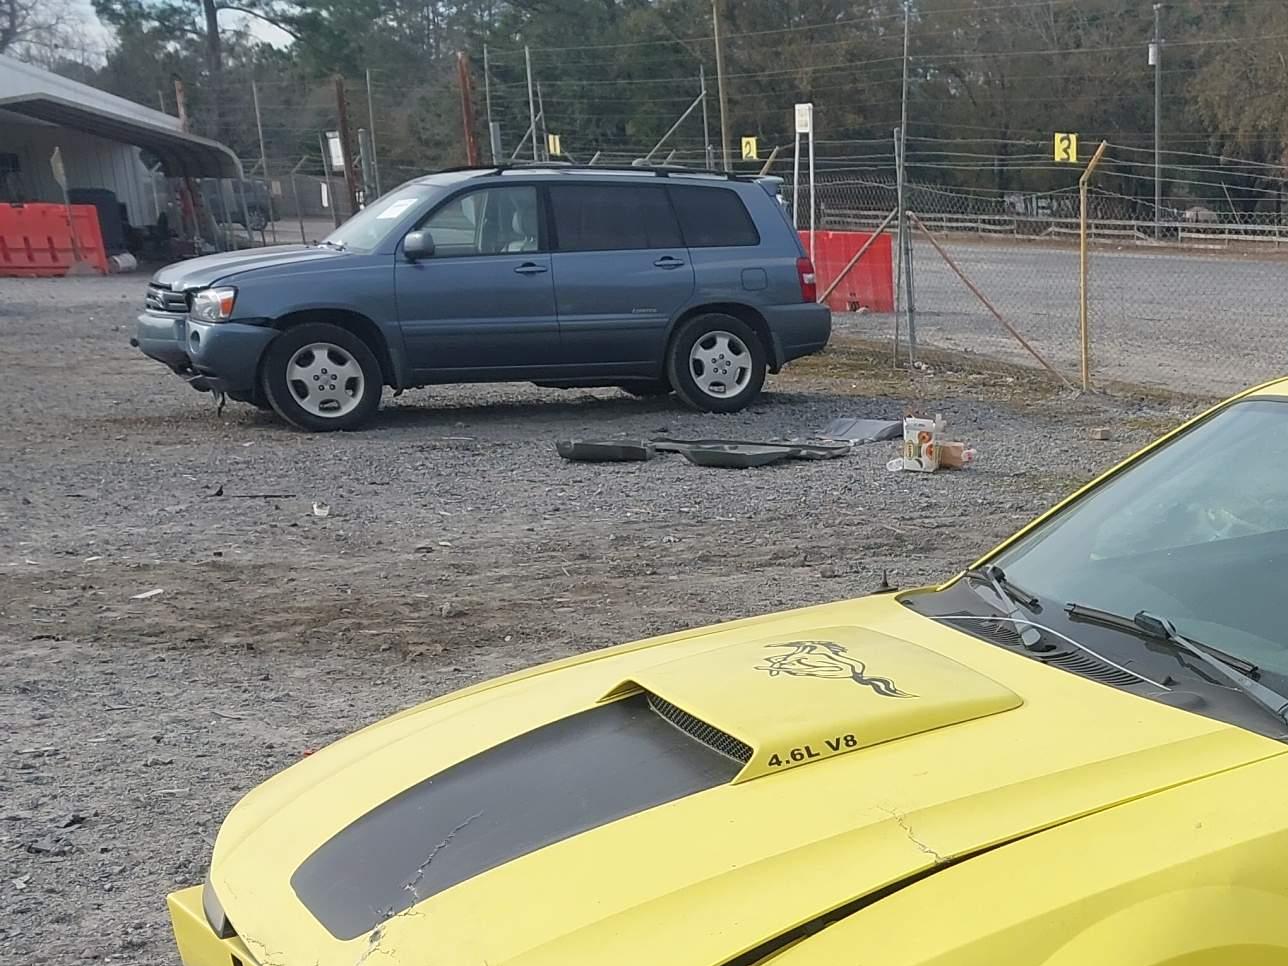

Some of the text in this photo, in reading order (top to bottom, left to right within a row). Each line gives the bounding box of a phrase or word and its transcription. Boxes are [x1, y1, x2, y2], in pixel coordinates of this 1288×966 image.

[744, 140, 754, 159] 2
[1060, 135, 1071, 161] 3
[768, 734, 858, 767] 4.6L V8
